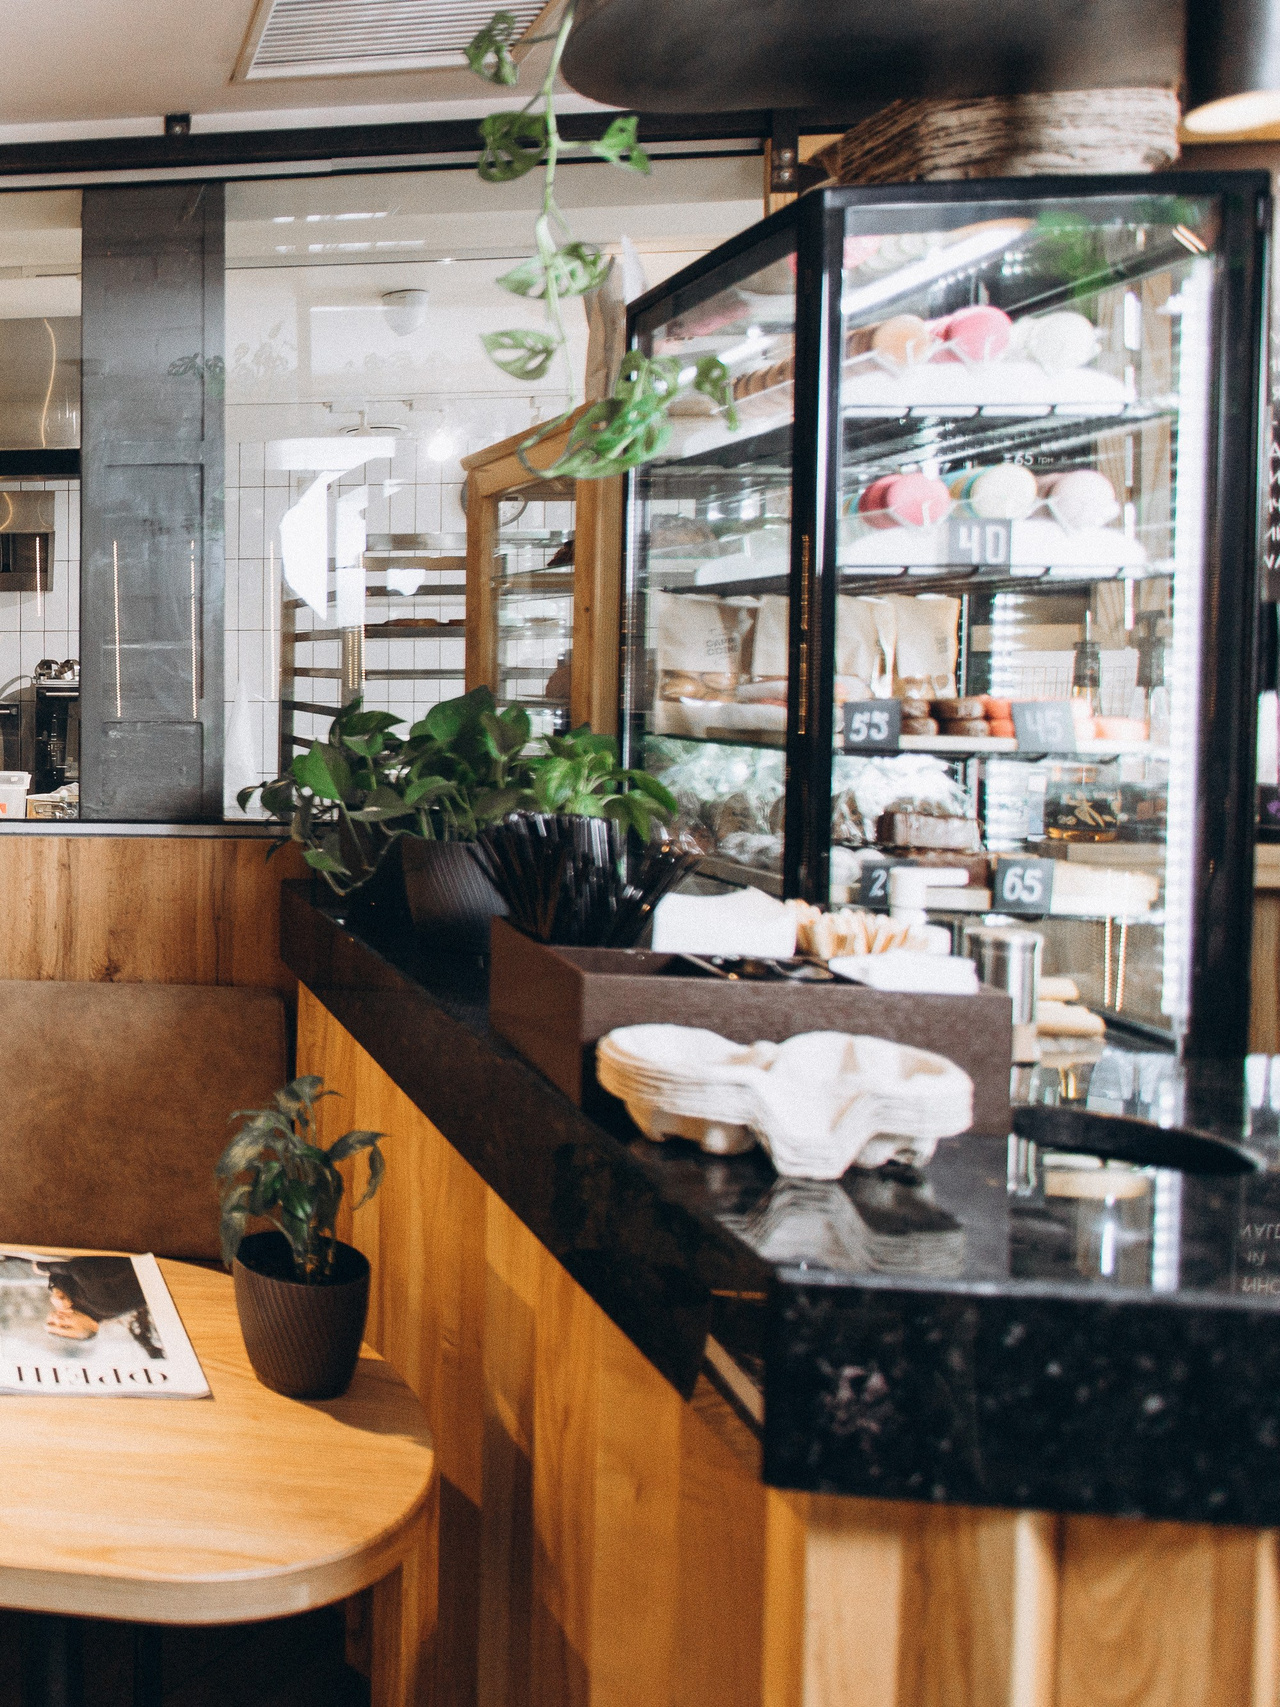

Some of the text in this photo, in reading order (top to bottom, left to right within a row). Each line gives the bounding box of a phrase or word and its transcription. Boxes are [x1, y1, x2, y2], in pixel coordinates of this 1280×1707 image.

[958, 524, 1008, 564] 40
[849, 710, 890, 742] 55
[869, 868, 889, 897] 2
[1002, 866, 1042, 903] 65
